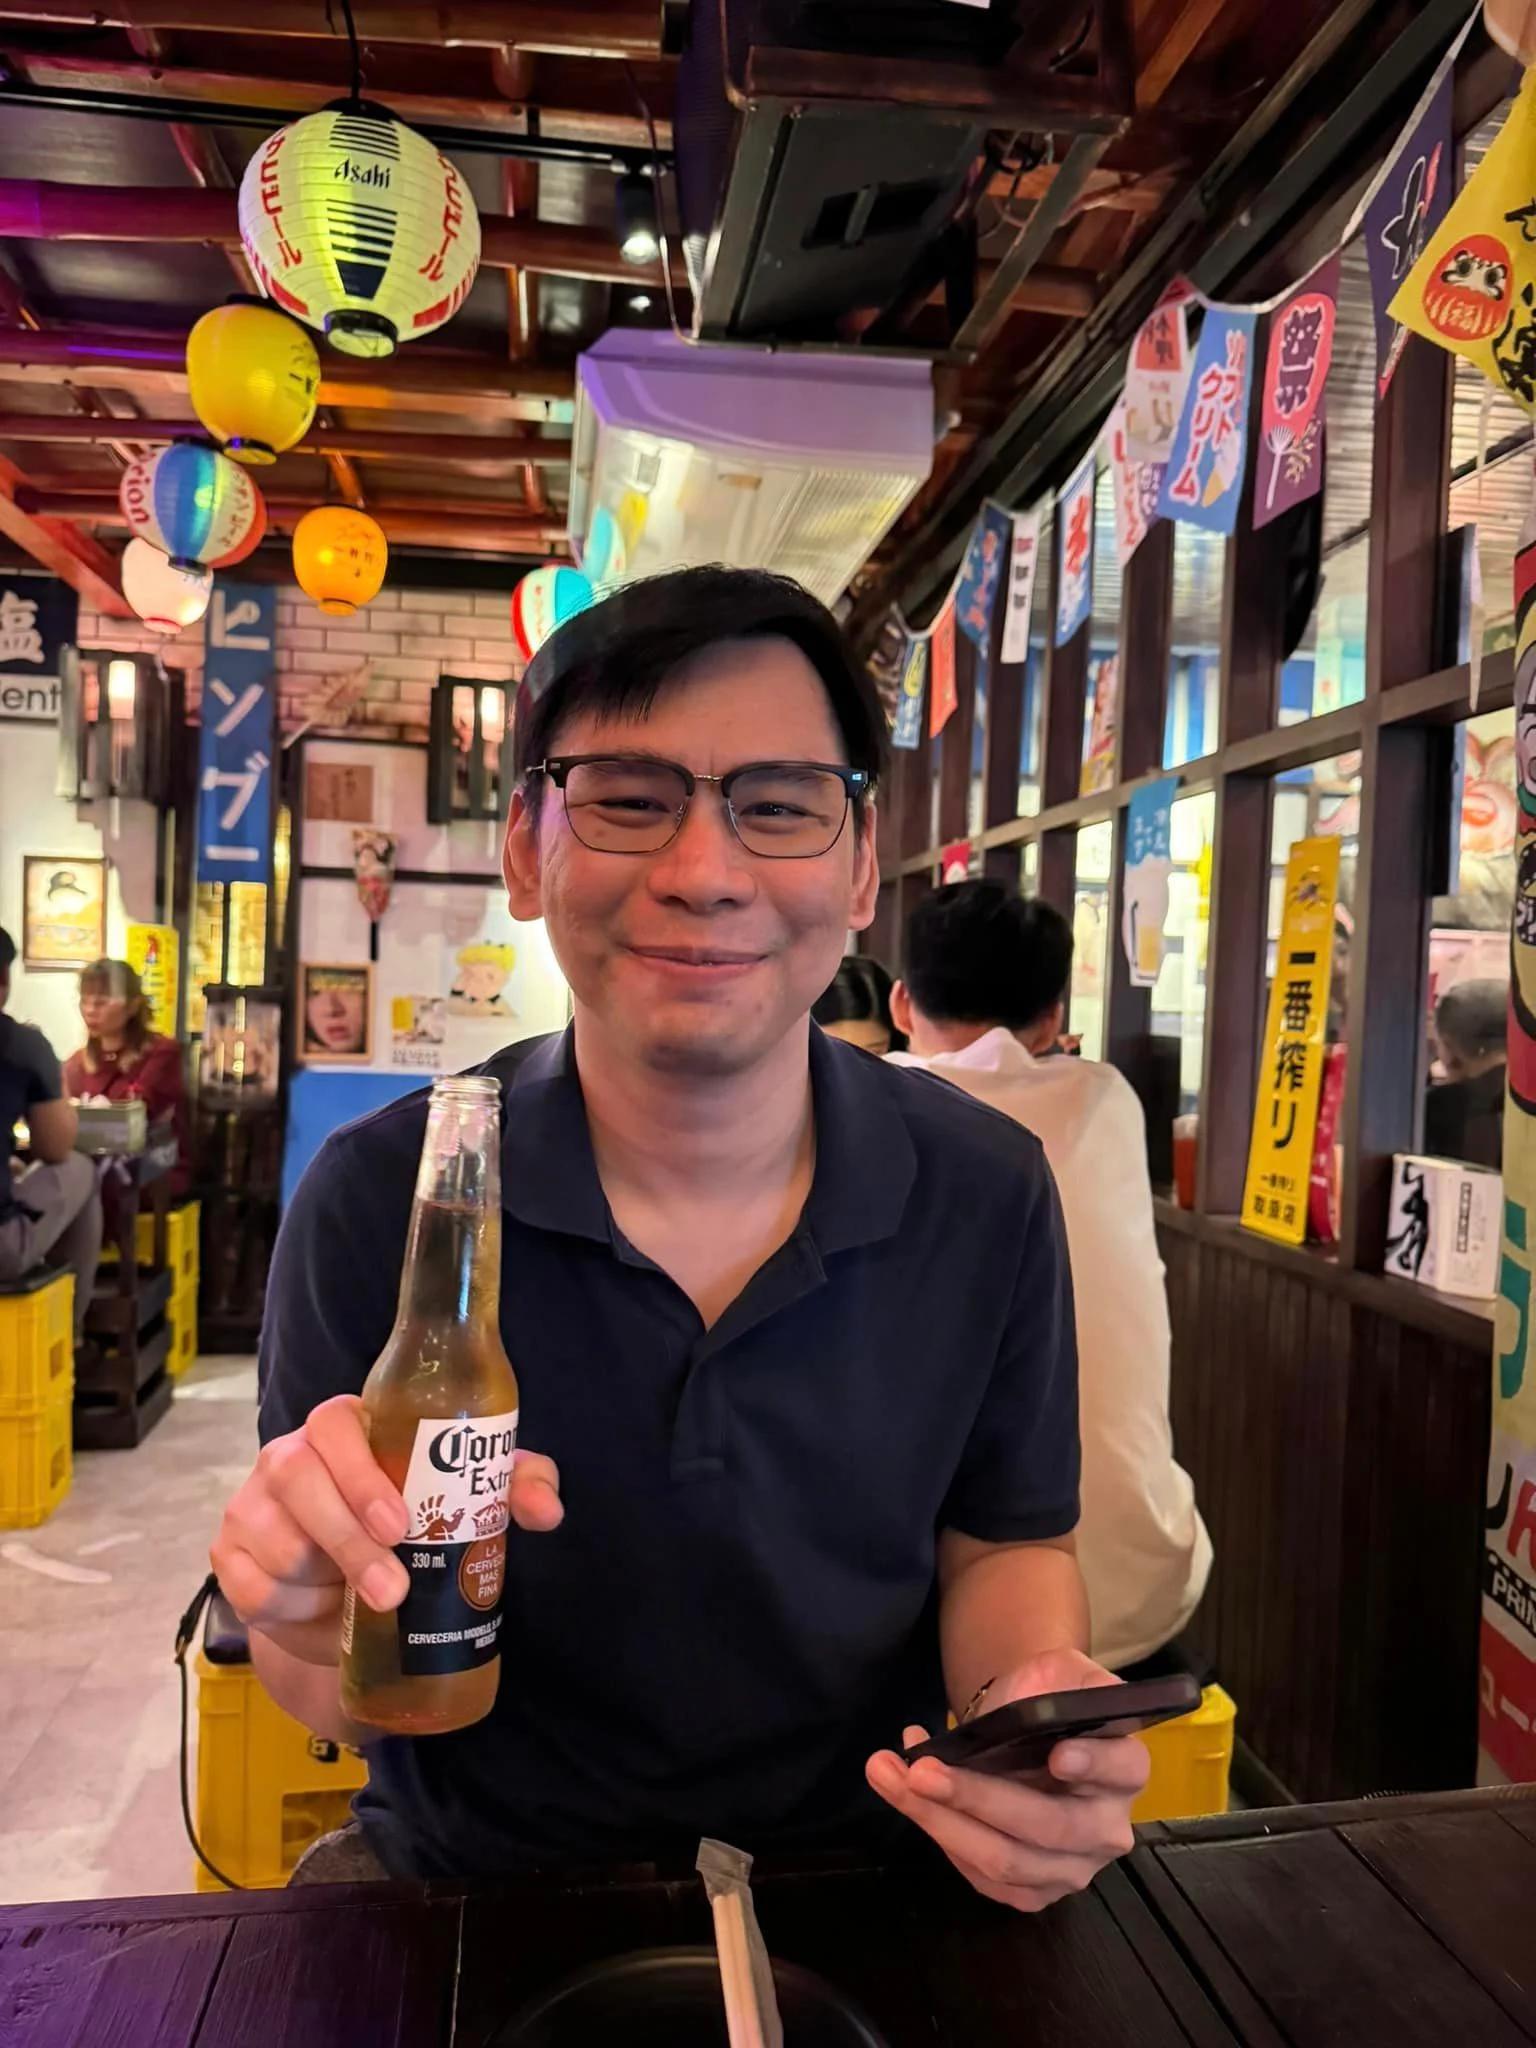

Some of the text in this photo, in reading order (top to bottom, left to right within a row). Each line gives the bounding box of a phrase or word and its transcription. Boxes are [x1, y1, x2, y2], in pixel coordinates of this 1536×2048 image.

[334, 159, 392, 189] Asahi
[1170, 363, 1225, 504] クリーム
[0, 683, 62, 712] ent
[1273, 950, 1317, 1150] 一番搾り
[411, 1552, 447, 1569] 330 ml.
[485, 1544, 498, 1558] LA
[477, 1583, 498, 1600] FINA
[408, 1629, 463, 1645] CERVECERIA
